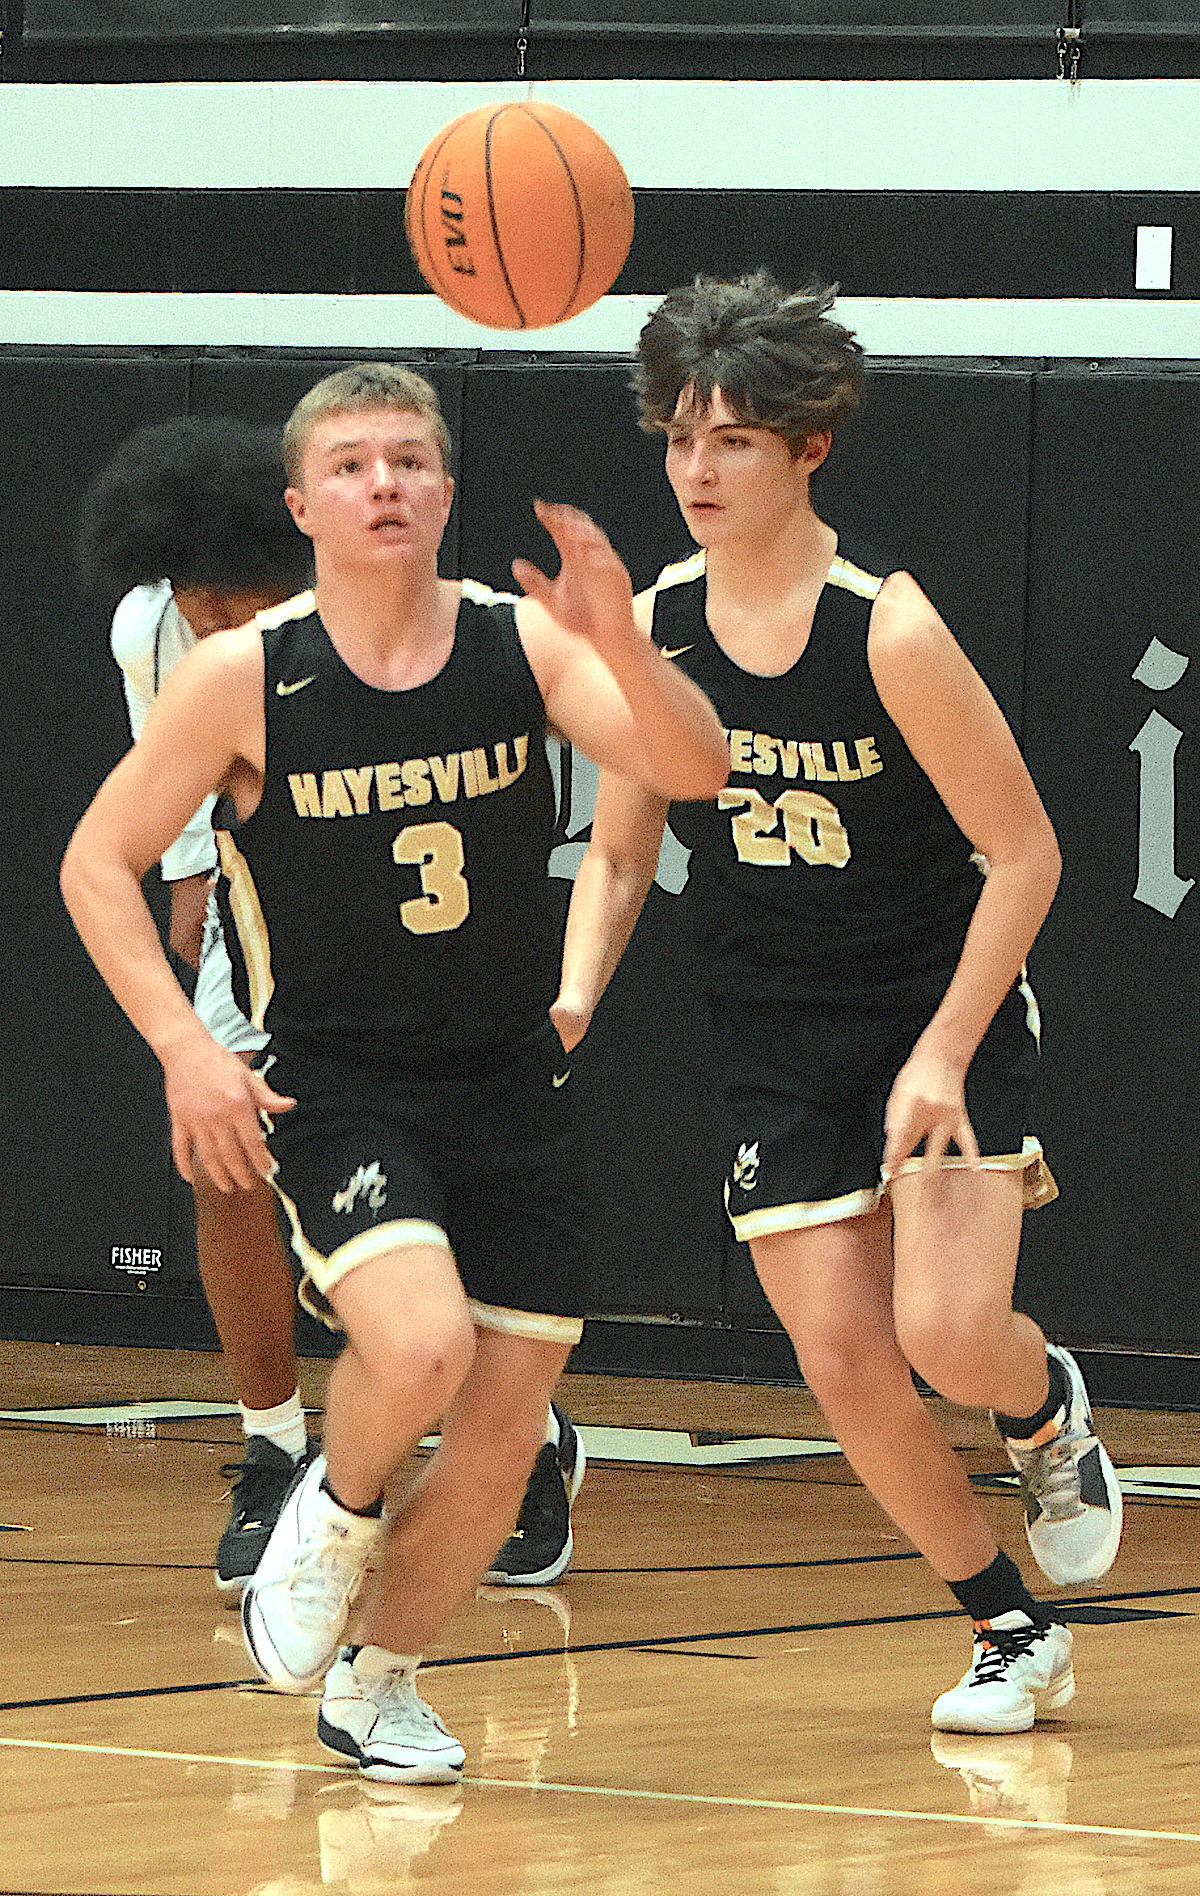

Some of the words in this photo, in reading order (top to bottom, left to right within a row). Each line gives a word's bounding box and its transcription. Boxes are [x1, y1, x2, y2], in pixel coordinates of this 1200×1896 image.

[441, 190, 477, 276] EVO
[724, 728, 884, 782] ESVILLE
[717, 787, 851, 869] 20
[392, 821, 470, 935] 3
[111, 1246, 162, 1268] FISHER
